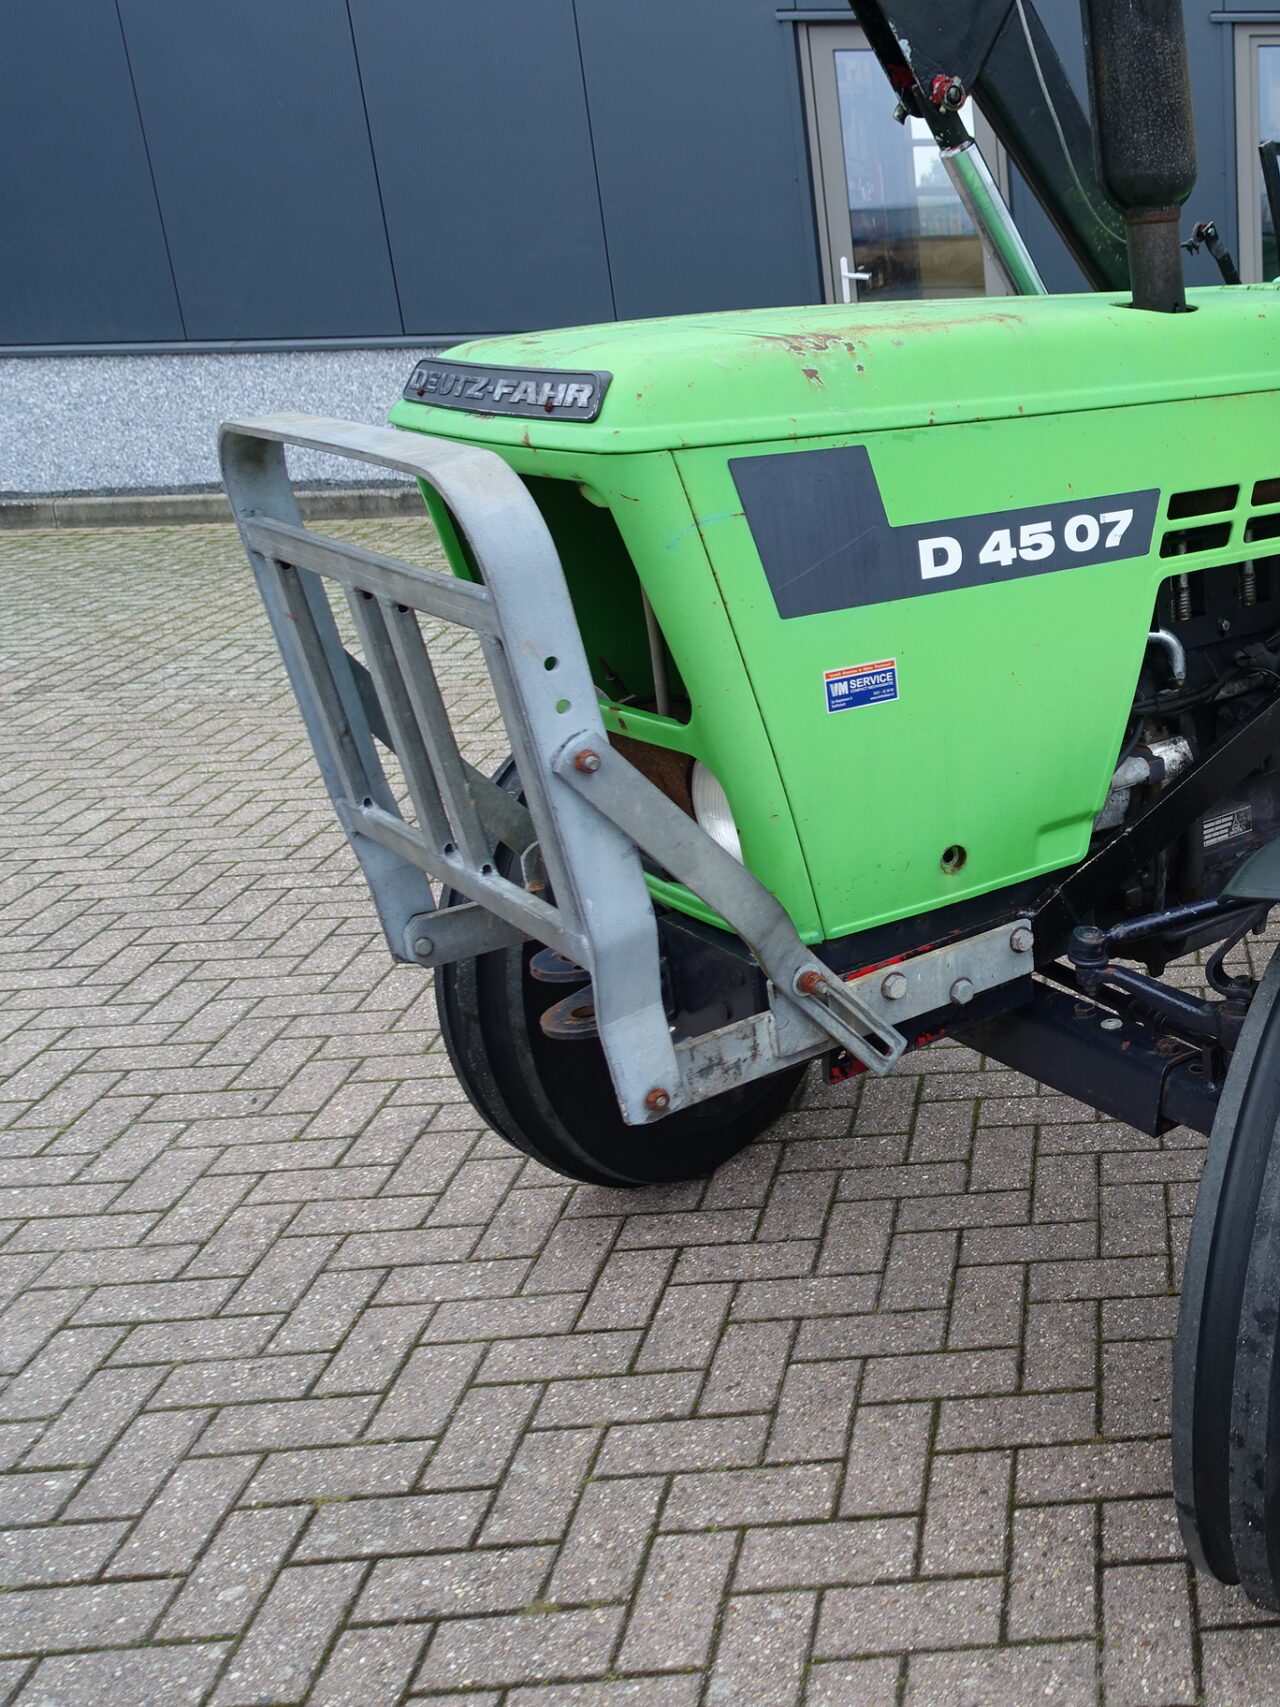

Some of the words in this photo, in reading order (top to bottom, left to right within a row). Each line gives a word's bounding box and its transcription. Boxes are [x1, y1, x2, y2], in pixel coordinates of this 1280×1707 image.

[410, 368, 594, 408] DEUTZ-FAHR
[918, 536, 963, 580] D
[978, 509, 1134, 566] 4507
[829, 681, 849, 697] VM
[849, 672, 894, 689] SERVICE
